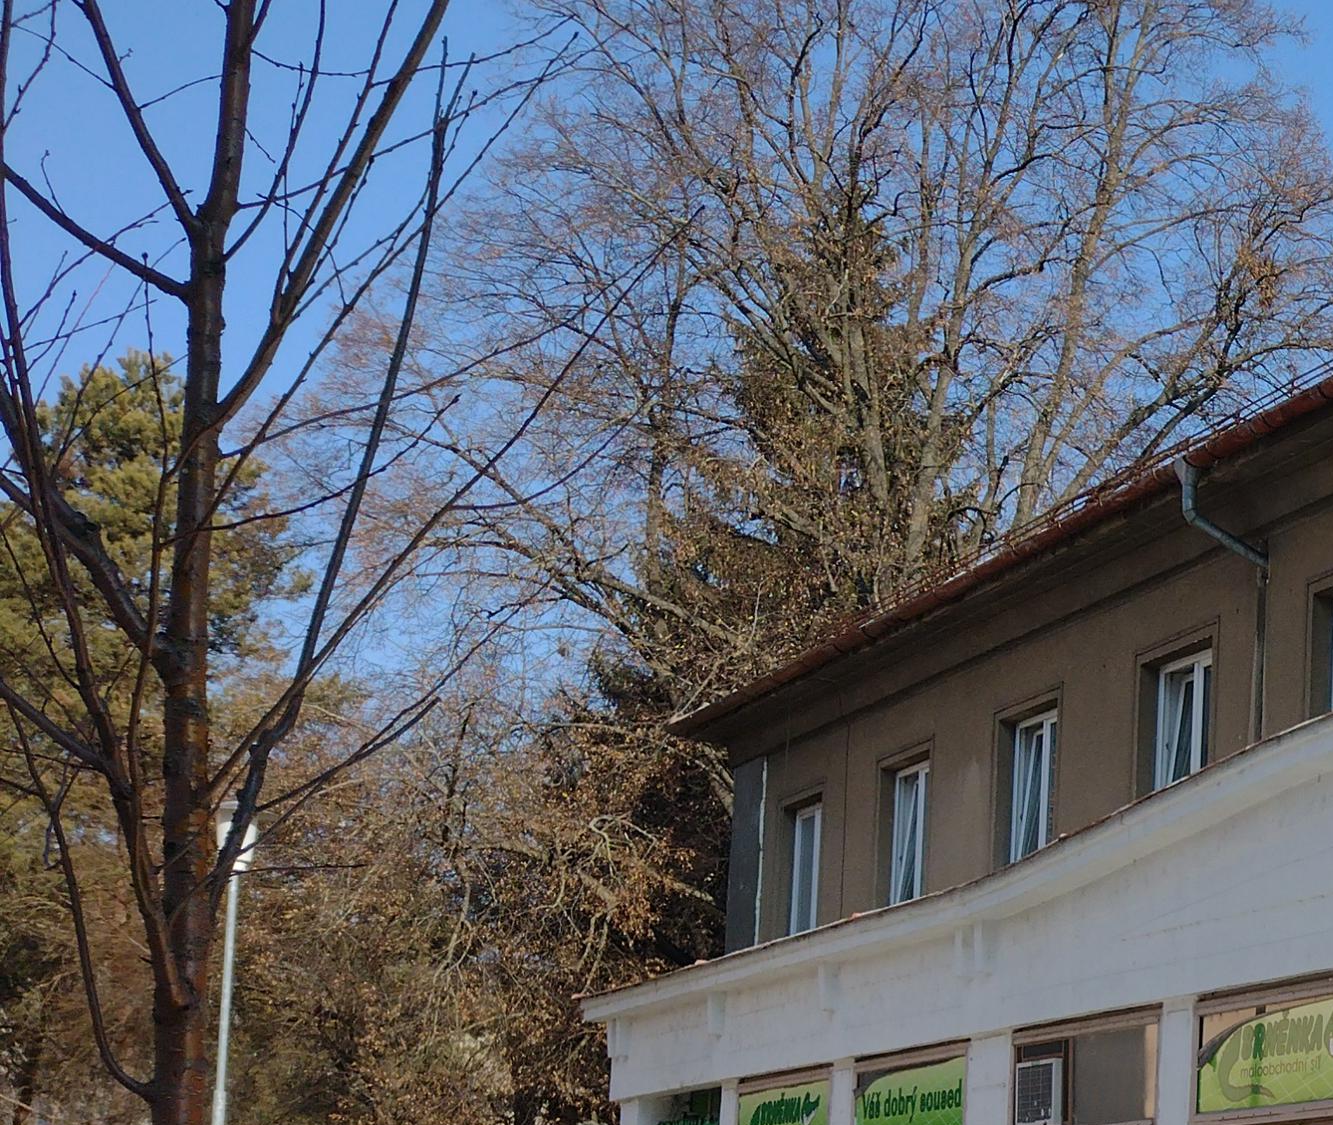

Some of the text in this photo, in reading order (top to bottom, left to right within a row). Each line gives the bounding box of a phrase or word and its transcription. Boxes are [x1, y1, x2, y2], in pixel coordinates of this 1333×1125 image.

[1241, 1009, 1324, 1061] BRNĚNKA
[1240, 1058, 1308, 1079] maloobchodní
[862, 1078, 963, 1123] Váš dobrý soused
